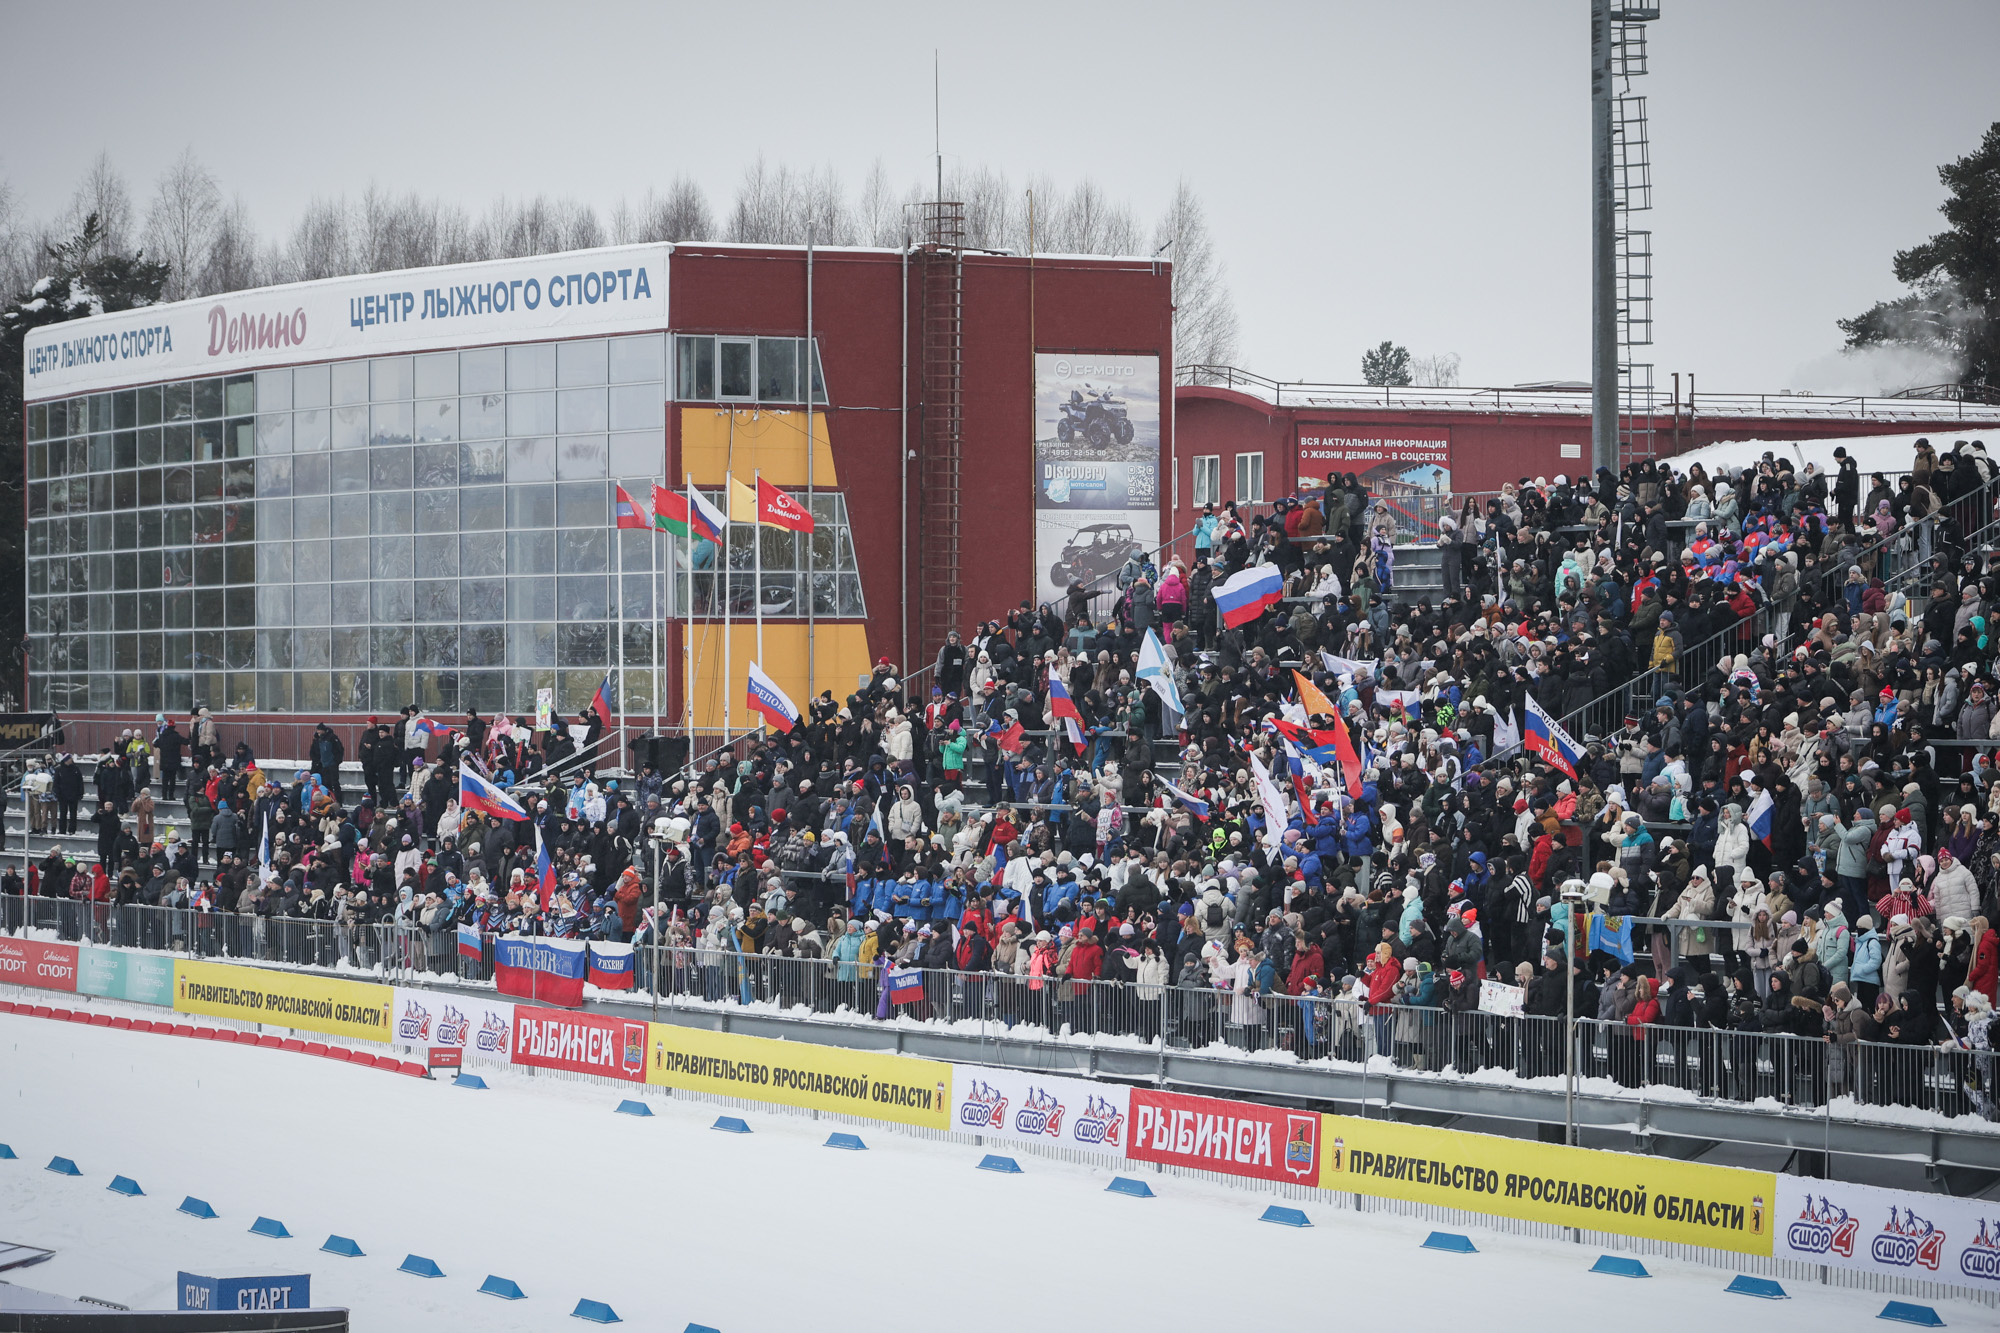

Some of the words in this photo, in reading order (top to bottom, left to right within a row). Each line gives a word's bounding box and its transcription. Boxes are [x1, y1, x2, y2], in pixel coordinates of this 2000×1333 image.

[350, 293, 414, 332] ЦЕНТР
[420, 279, 541, 319] ЛЫЖНОГО
[548, 267, 652, 305] СПОРТА
[208, 305, 307, 357] Демино
[28, 346, 58, 377] ЦЕНТР
[60, 335, 119, 368] ЛЫЖНОГО
[120, 326, 173, 358] СПОРТА
[1074, 365, 1135, 377] CFMOTO
[1301, 437, 1319, 446] ВСЯ
[1322, 437, 1382, 448] АКТУАЛЬНАЯ
[1384, 439, 1447, 449] ИНФОРМАЦИЯ
[1301, 450, 1308, 459] О
[1310, 450, 1342, 459] ЖИЗНИ
[1345, 451, 1383, 461] ДЕМИНО
[1392, 453, 1398, 461] В
[1400, 452, 1447, 462] СОЦСЕТЯХ
[1044, 464, 1107, 481] Discovery
[0, 958, 27, 973] ПОРТ
[37, 963, 73, 979] СПОРТ
[507, 945, 557, 973] ТИХВИН
[189, 982, 263, 1009] ПРАВИТЕЛЬСТВО
[265, 993, 333, 1019] ЯРОСЛАВСКОЙ
[335, 1004, 381, 1027] ОБЛАСТИ
[518, 1018, 615, 1067] РЫБИНСК
[666, 1051, 769, 1085] ПРАВИТЕЛЬСТВО
[773, 1067, 868, 1099] ЯРОСЛАВСКОЙ
[872, 1082, 932, 1109] ОБЛАСТИ
[1135, 1104, 1273, 1167] РЫБИНСК
[1350, 1150, 1499, 1196] ПРАВИТЕЛЬСТВО
[1505, 1172, 1647, 1216] ЯРОСЛАВСКОЙ
[1653, 1195, 1745, 1231] ОБЛАСТИ
[185, 1284, 210, 1310] СТАРТ
[237, 1287, 293, 1310] СТАРТ
